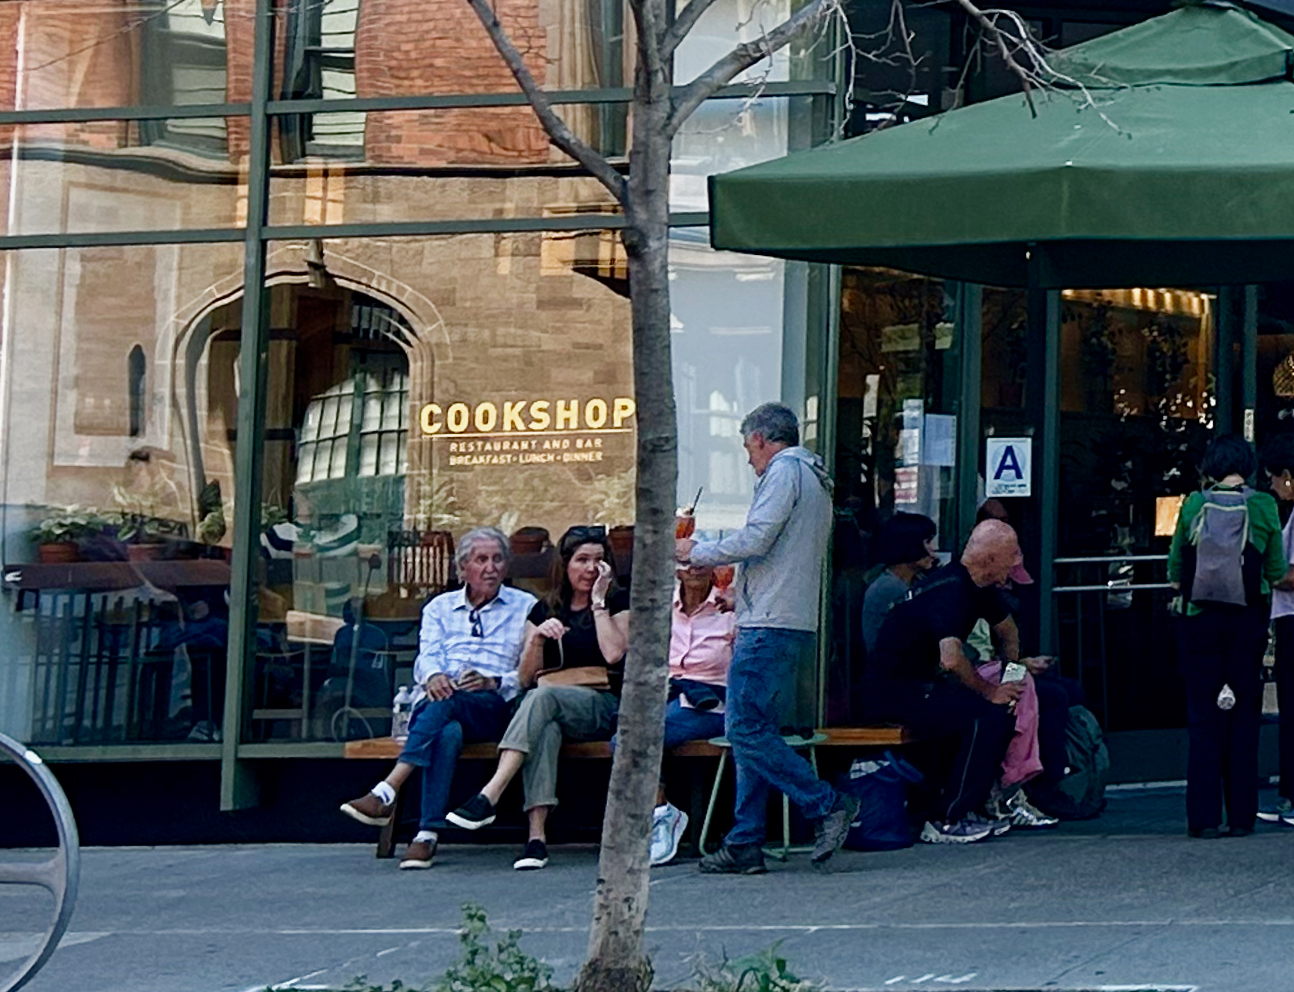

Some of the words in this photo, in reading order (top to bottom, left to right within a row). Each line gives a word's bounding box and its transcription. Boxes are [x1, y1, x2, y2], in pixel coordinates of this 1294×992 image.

[420, 398, 636, 433] COOKSHOP
[450, 439, 537, 452] RESTAURANT
[543, 439, 570, 450] AND
[576, 438, 603, 448] BAR
[993, 445, 1024, 480] A
